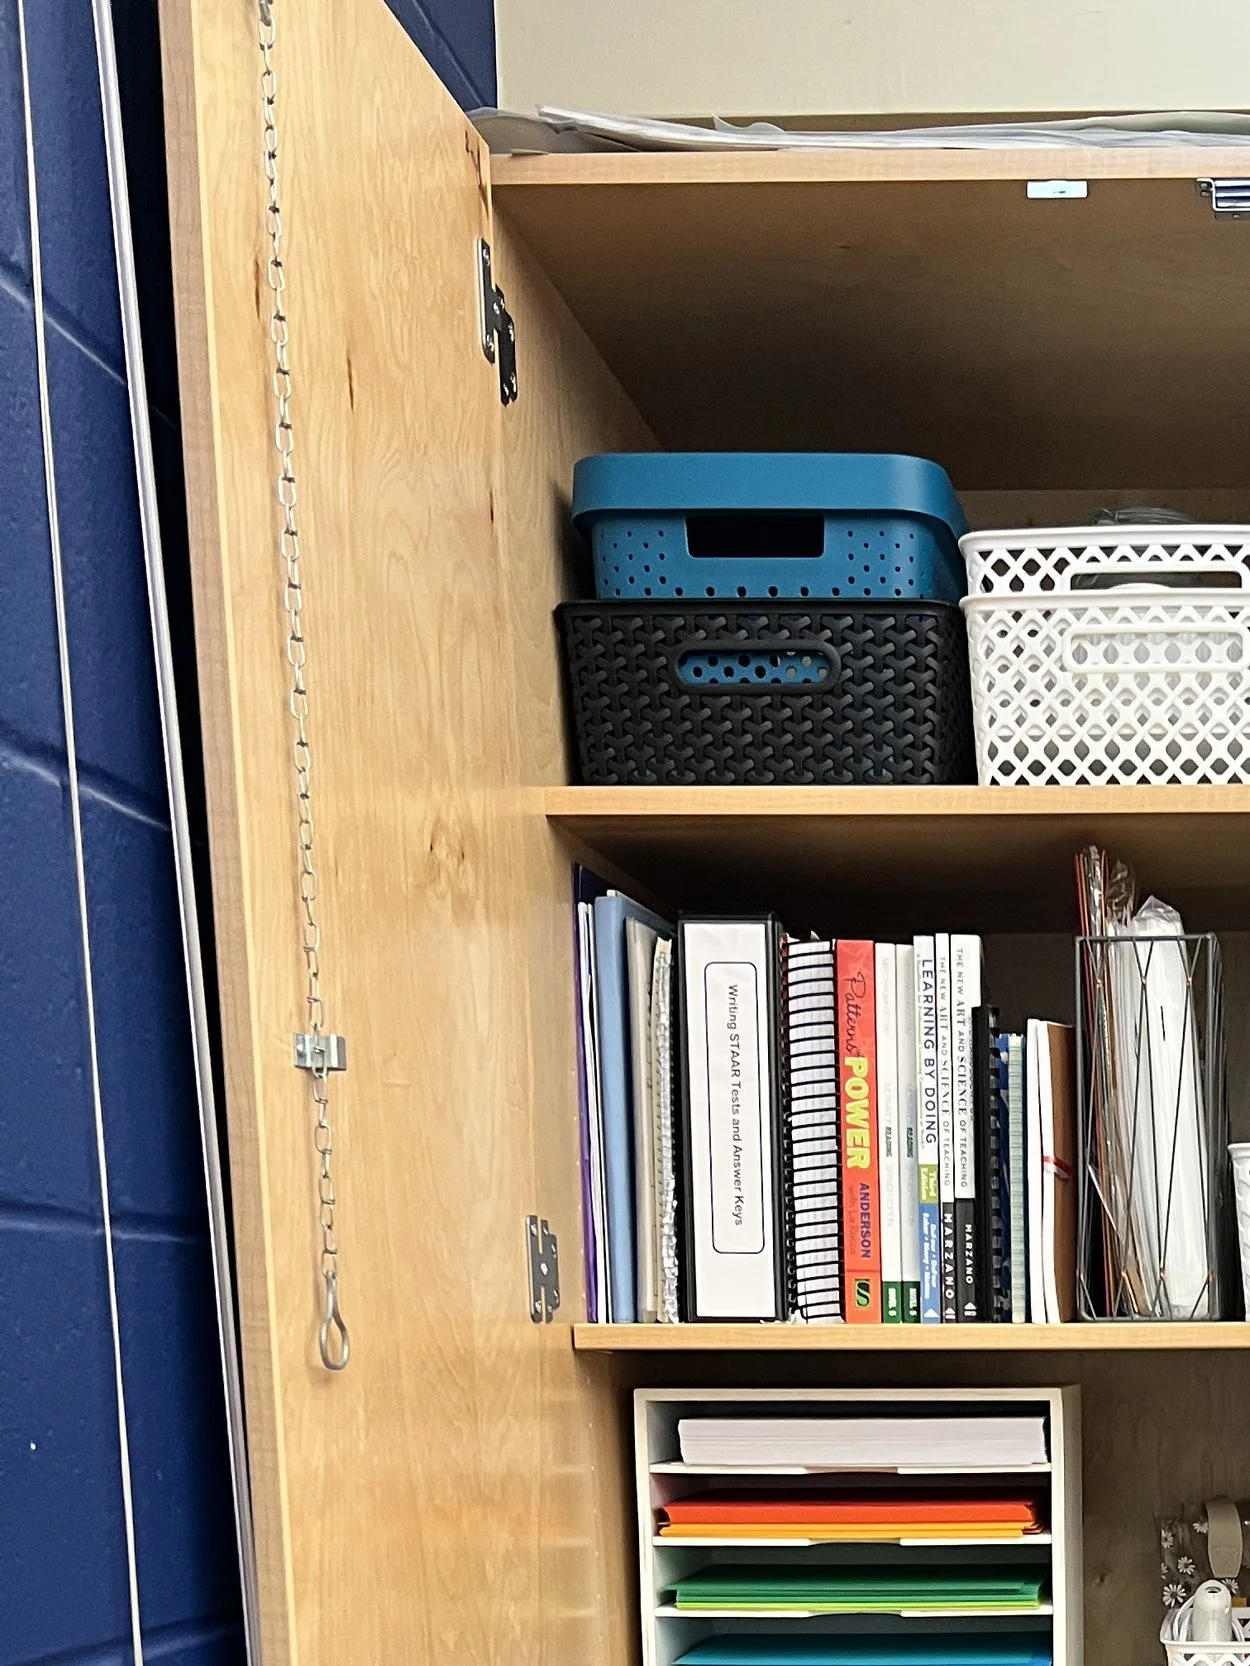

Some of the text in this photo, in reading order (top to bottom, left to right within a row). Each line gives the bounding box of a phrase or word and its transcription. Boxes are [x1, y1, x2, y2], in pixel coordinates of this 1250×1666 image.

[939, 1006, 948, 1030] ART
[957, 1000, 966, 1027] ART
[922, 959, 937, 1144] LEARNING BY DOING
[726, 984, 744, 1226] Writing STAAR Tests and Answer Keys
[844, 1056, 871, 1169] POWER
[940, 1059, 950, 1118] SCIENCE
[957, 1056, 967, 1116] SCIENCE
[943, 1121, 950, 1134] OF
[959, 1119, 967, 1134] OF
[943, 1137, 951, 1186] TEACHING
[959, 1137, 968, 1188] TEACHING
[859, 1182, 871, 1258] ANDERSON
[943, 1213, 955, 1299] MARZANO
[964, 1224, 976, 1284] MARZANO
